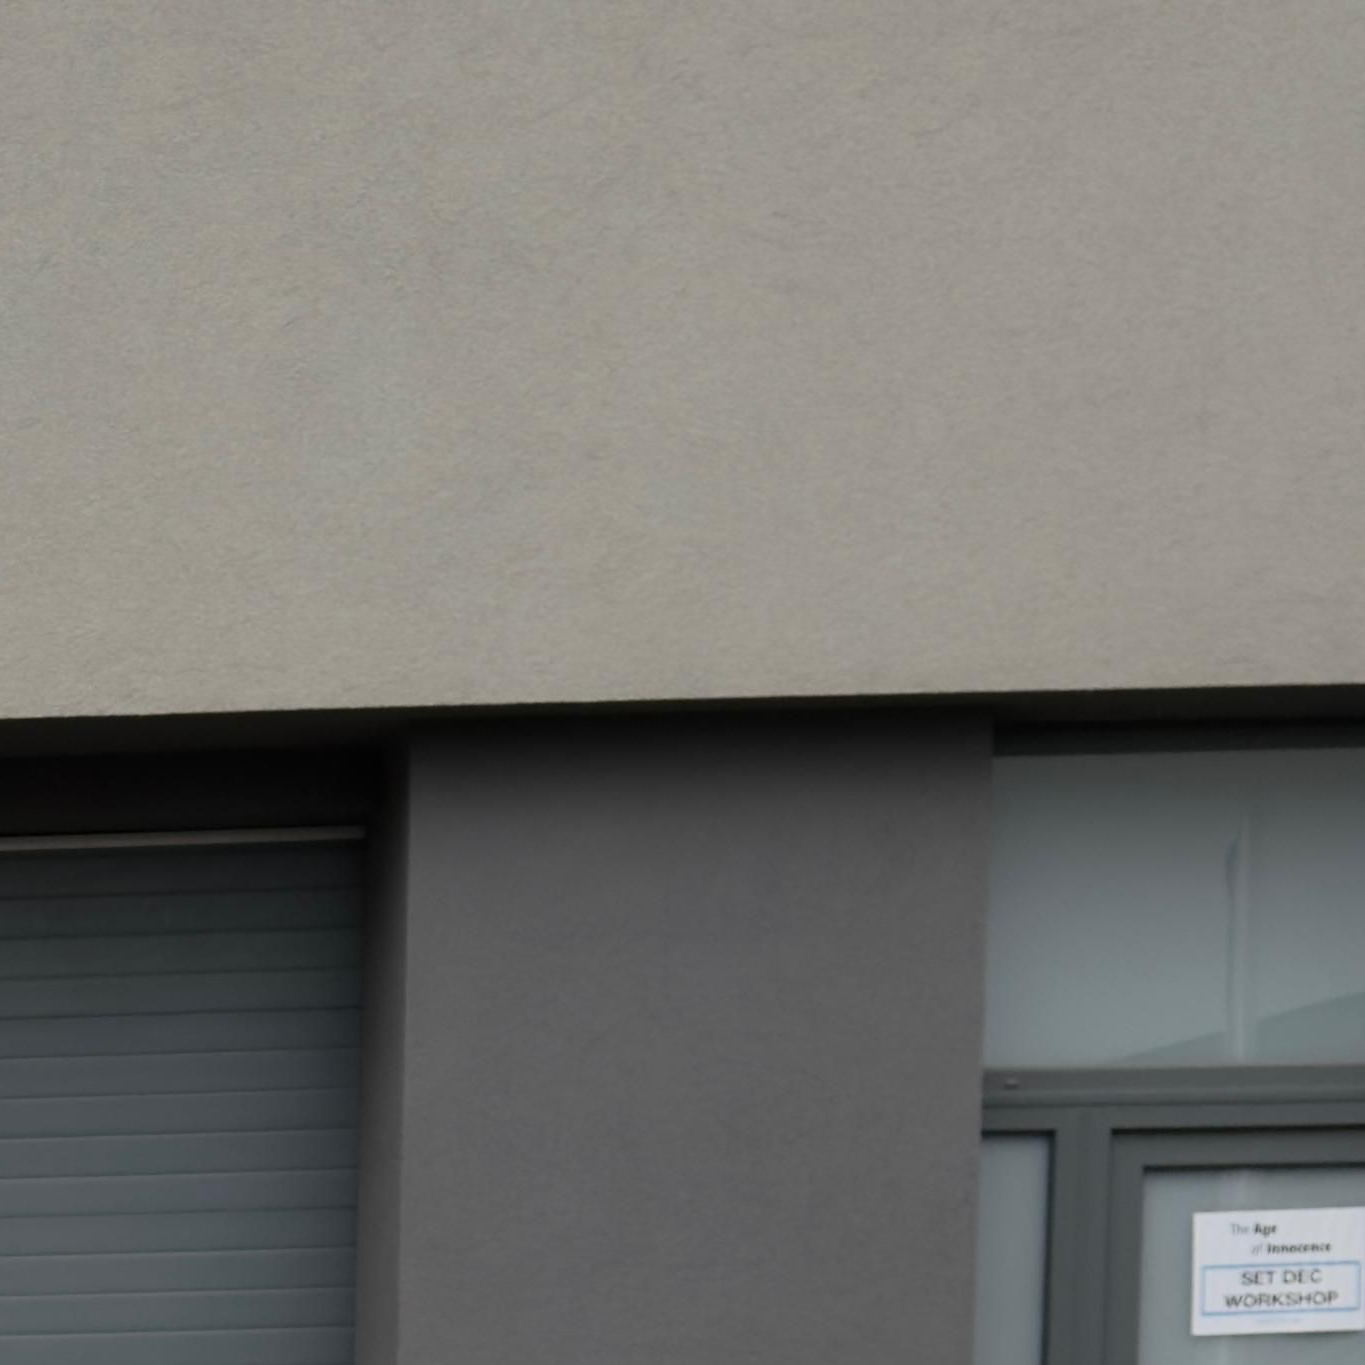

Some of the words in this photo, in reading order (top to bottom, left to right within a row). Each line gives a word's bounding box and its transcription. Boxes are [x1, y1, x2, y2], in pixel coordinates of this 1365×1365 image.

[1231, 1223, 1250, 1235] The
[1254, 1222, 1277, 1238] Age
[1241, 1270, 1276, 1286] SET
[1282, 1269, 1323, 1285] DEC
[1224, 1291, 1338, 1308] WORKSHOP
